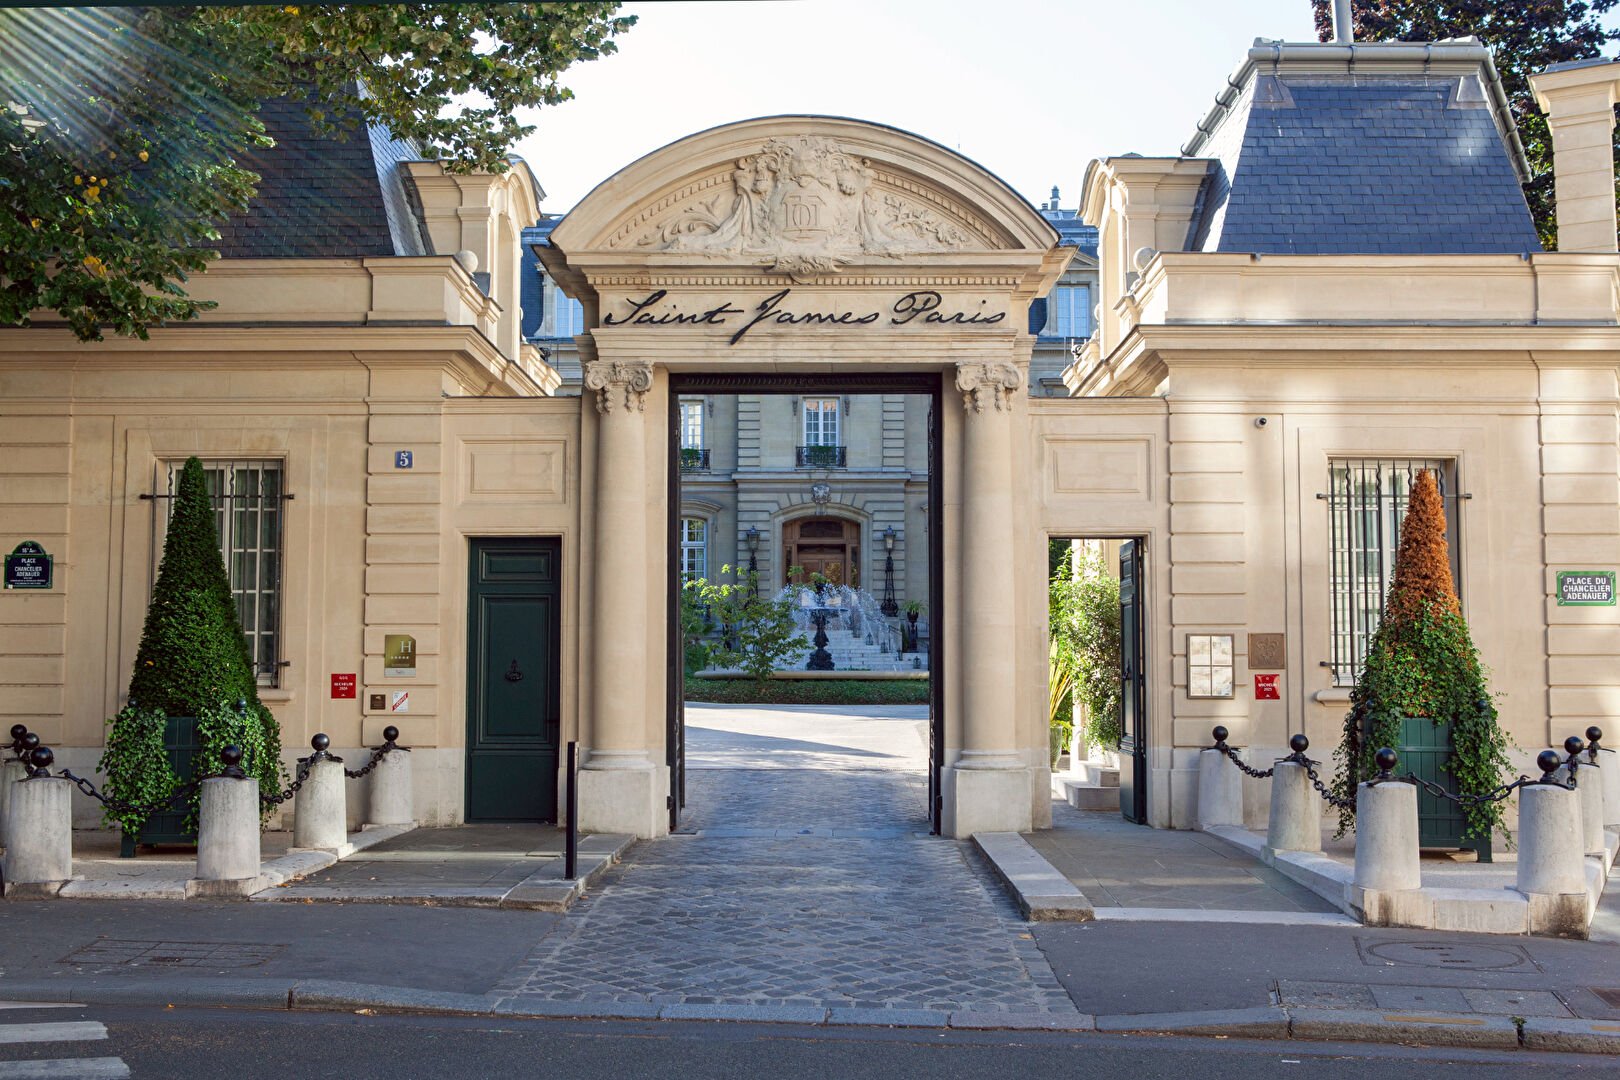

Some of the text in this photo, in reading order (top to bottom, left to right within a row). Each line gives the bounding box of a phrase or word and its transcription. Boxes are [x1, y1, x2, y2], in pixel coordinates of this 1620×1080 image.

[603, 288, 1007, 345] Saint James Paris
[399, 452, 409, 467] 5
[1566, 577, 1606, 585] PLACE DU
[1566, 592, 1608, 600] ADENAUER
[400, 640, 412, 653] H
